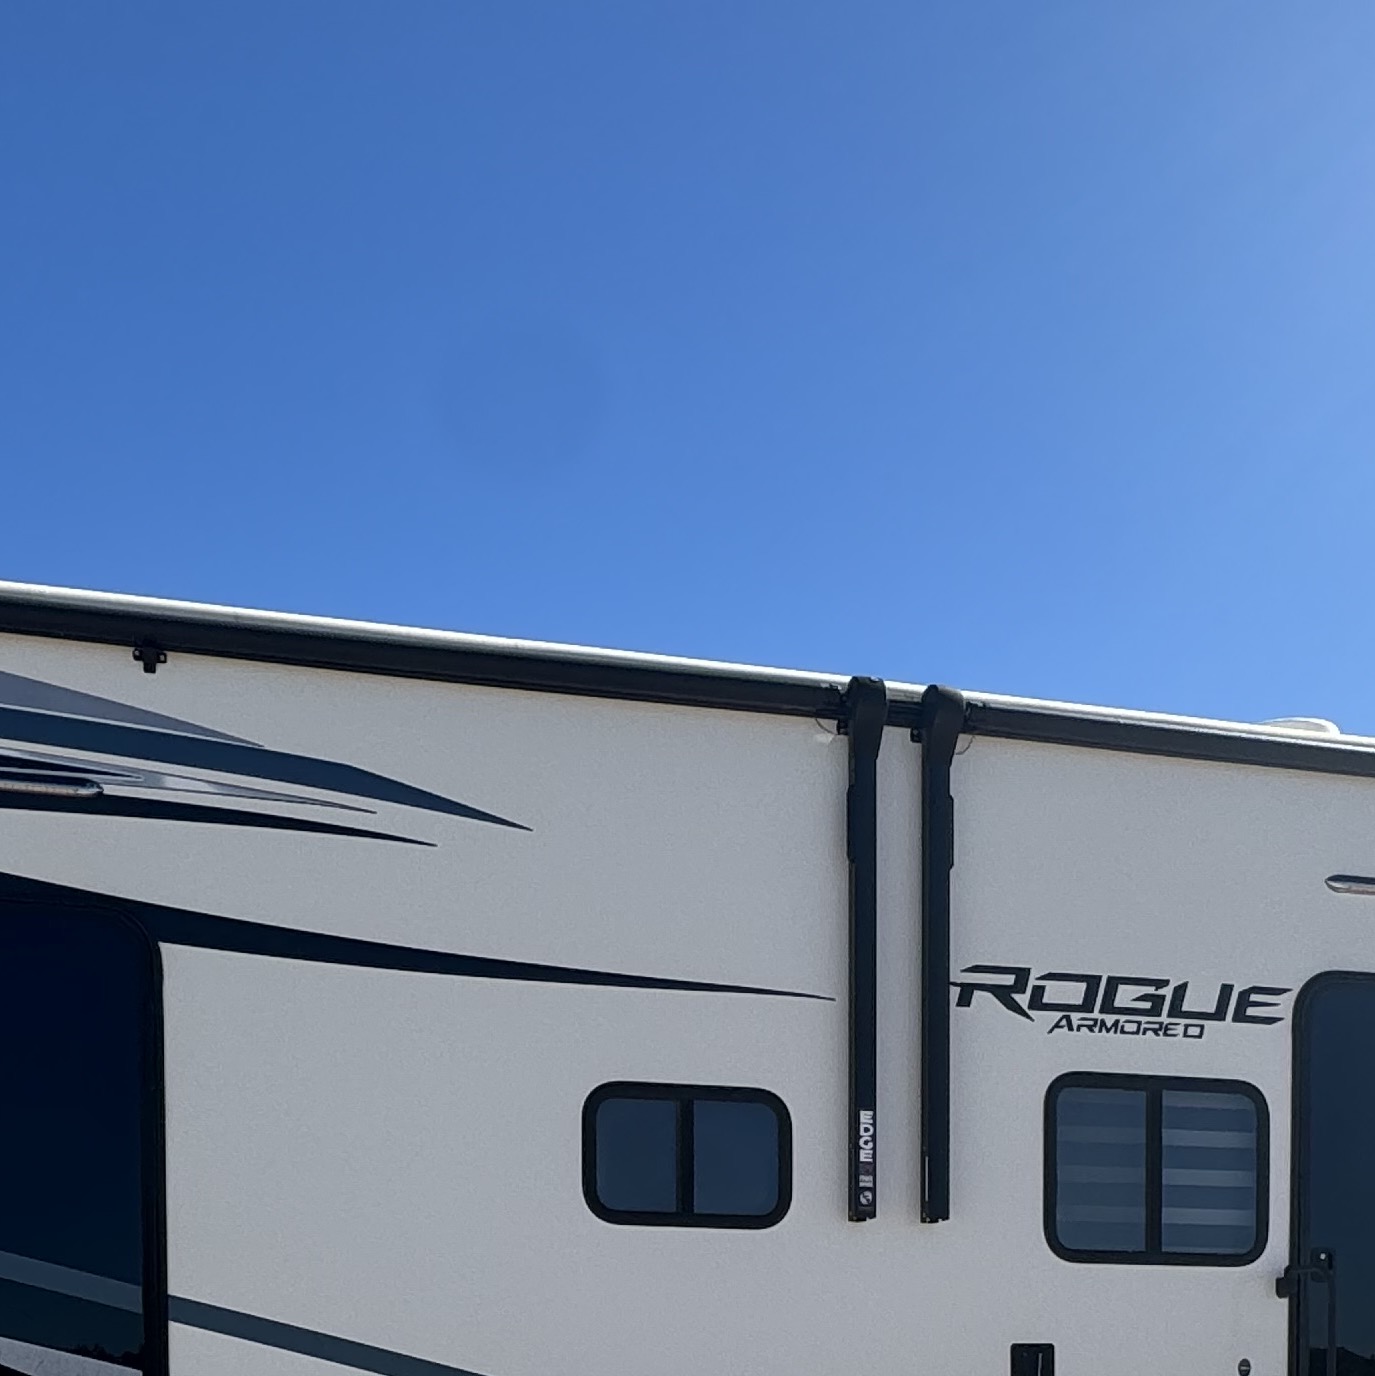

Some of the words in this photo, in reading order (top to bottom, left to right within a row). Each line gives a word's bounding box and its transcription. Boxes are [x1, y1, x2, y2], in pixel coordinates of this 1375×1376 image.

[949, 964, 1293, 1025] ROGUE
[1048, 1014, 1205, 1039] ARMORED
[859, 1110, 874, 1162] EDGE
